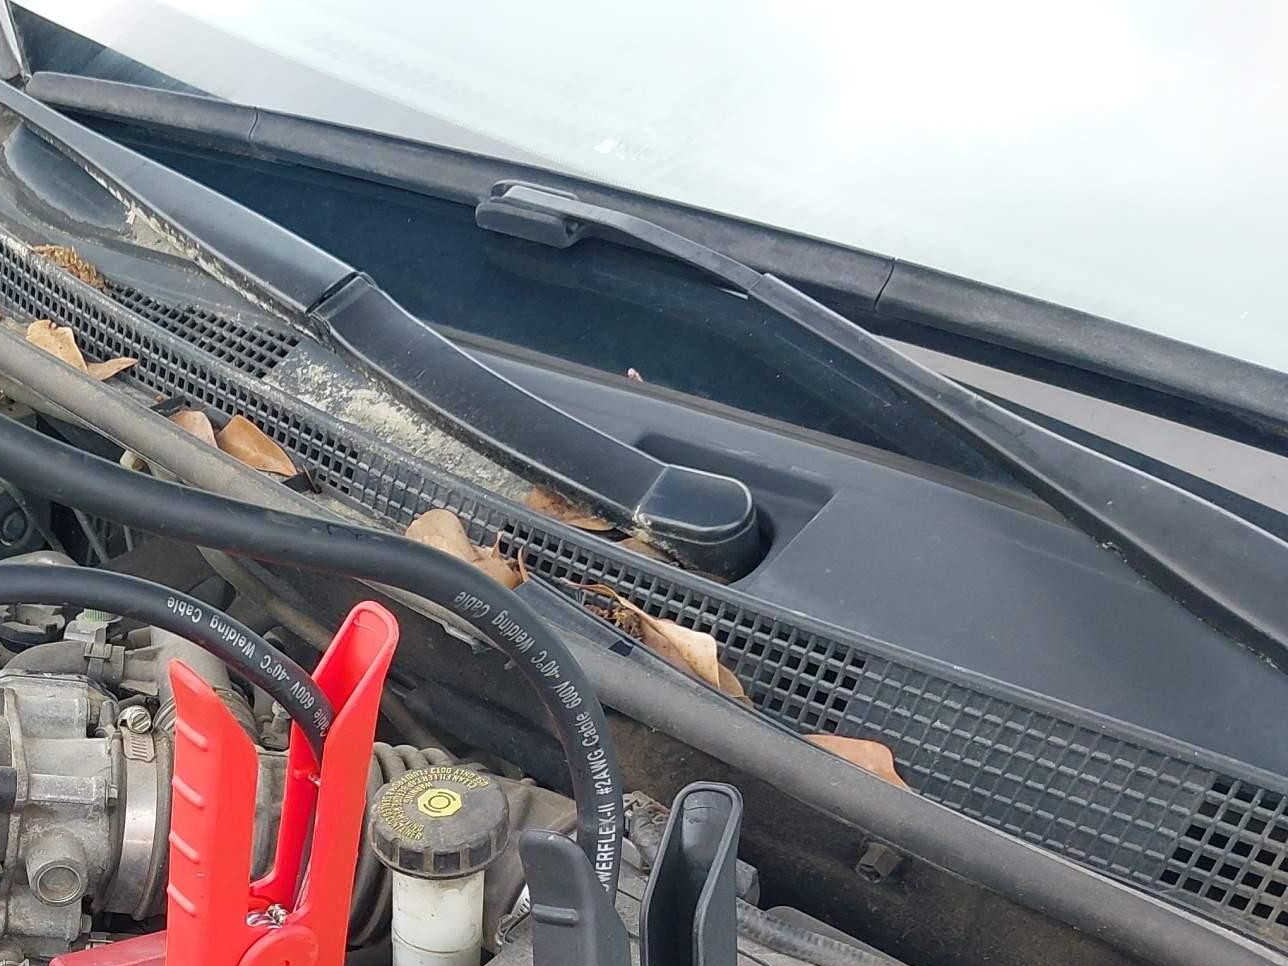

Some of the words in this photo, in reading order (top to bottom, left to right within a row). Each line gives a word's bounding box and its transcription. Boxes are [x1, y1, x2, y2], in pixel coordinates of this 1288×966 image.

[166, 596, 203, 624] Cable
[453, 590, 491, 619] Cable
[209, 614, 256, 658] Welding
[491, 609, 536, 653] Welding
[258, 653, 290, 682] -40°C
[530, 649, 562, 680] -40°C
[290, 680, 316, 710] 600V
[556, 678, 583, 710] 600V
[576, 711, 600, 748] Cable
[594, 746, 614, 796] #2AWG
